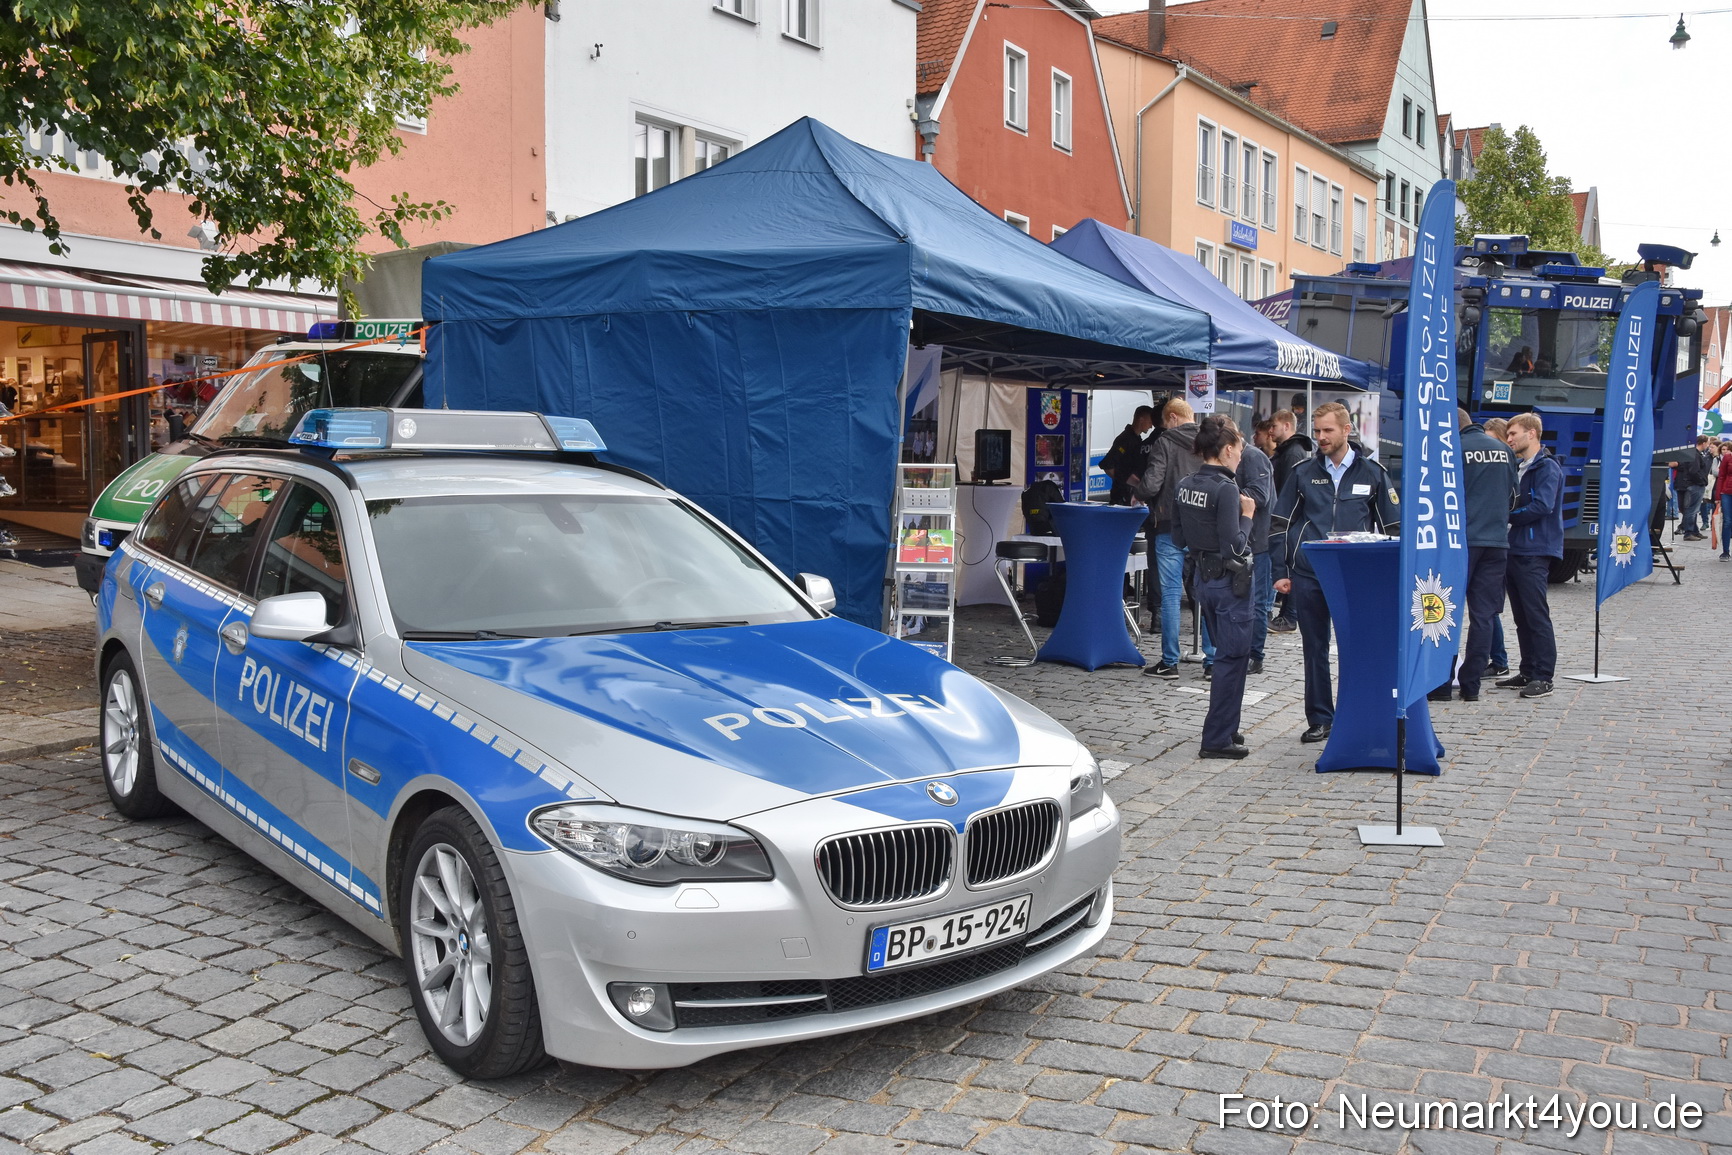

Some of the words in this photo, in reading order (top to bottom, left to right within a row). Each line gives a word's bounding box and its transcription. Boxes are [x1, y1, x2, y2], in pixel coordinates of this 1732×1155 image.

[355, 323, 413, 338] POLIZEI
[1563, 295, 1613, 310] POLIZEI
[1435, 295, 1450, 401] POLICE
[1204, 402, 1213, 410] 49
[1416, 231, 1437, 550] BUNDESPOLIZEI
[1617, 315, 1642, 510] BUNDESPOLIZEI
[1438, 412, 1462, 549] FEDERAL
[1465, 450, 1509, 464] POLIZEI
[1178, 487, 1208, 508] POLIZEI
[238, 655, 334, 752] POLIZEI
[702, 693, 956, 742] POLIZEI
[873, 952, 880, 962] D
[887, 925, 926, 962] BP
[939, 899, 1028, 951] 15-924
